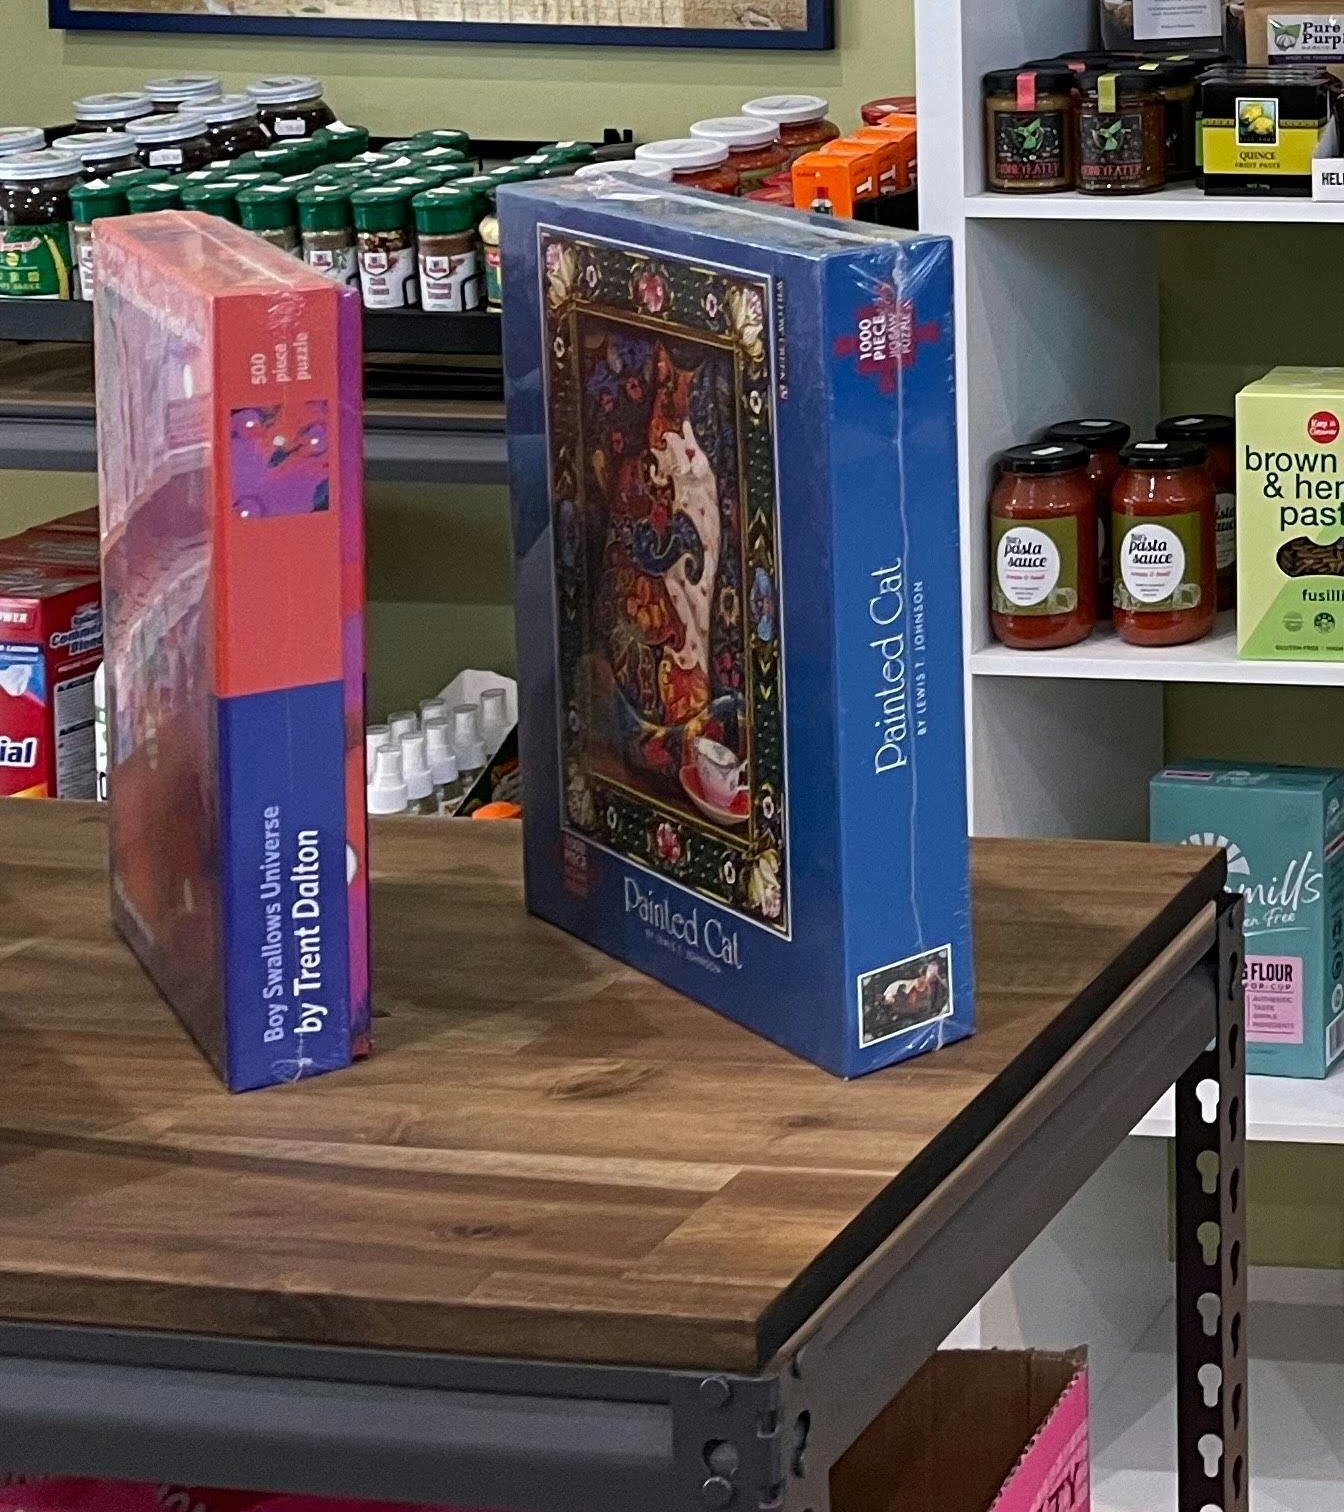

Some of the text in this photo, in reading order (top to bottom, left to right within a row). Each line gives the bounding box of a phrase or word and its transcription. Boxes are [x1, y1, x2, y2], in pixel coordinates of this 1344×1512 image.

[1303, 22, 1340, 33] Pure
[1240, 152, 1275, 161] QUINCE
[859, 319, 872, 360] 1000
[873, 315, 886, 360] PIECE
[251, 353, 266, 384] 500
[292, 332, 312, 380] puzzle
[1246, 445, 1337, 472] brown
[1264, 473, 1284, 498] &
[1005, 542, 1042, 556] pasta
[1129, 539, 1166, 554] pasta
[1133, 553, 1173, 564] sauce
[1008, 556, 1046, 567] sauce
[1303, 590, 1344, 601] fusilli
[870, 557, 907, 773] Painted Cat
[913, 581, 926, 736] BY LEWIS JOHNSON
[259, 805, 288, 1042] Boy Swallows Universe
[624, 877, 698, 946] Painted
[705, 919, 742, 969] Cat
[1264, 907, 1295, 928] Free
[290, 830, 328, 1033] by Trent Dalton
[1251, 963, 1292, 981] FLOUR
